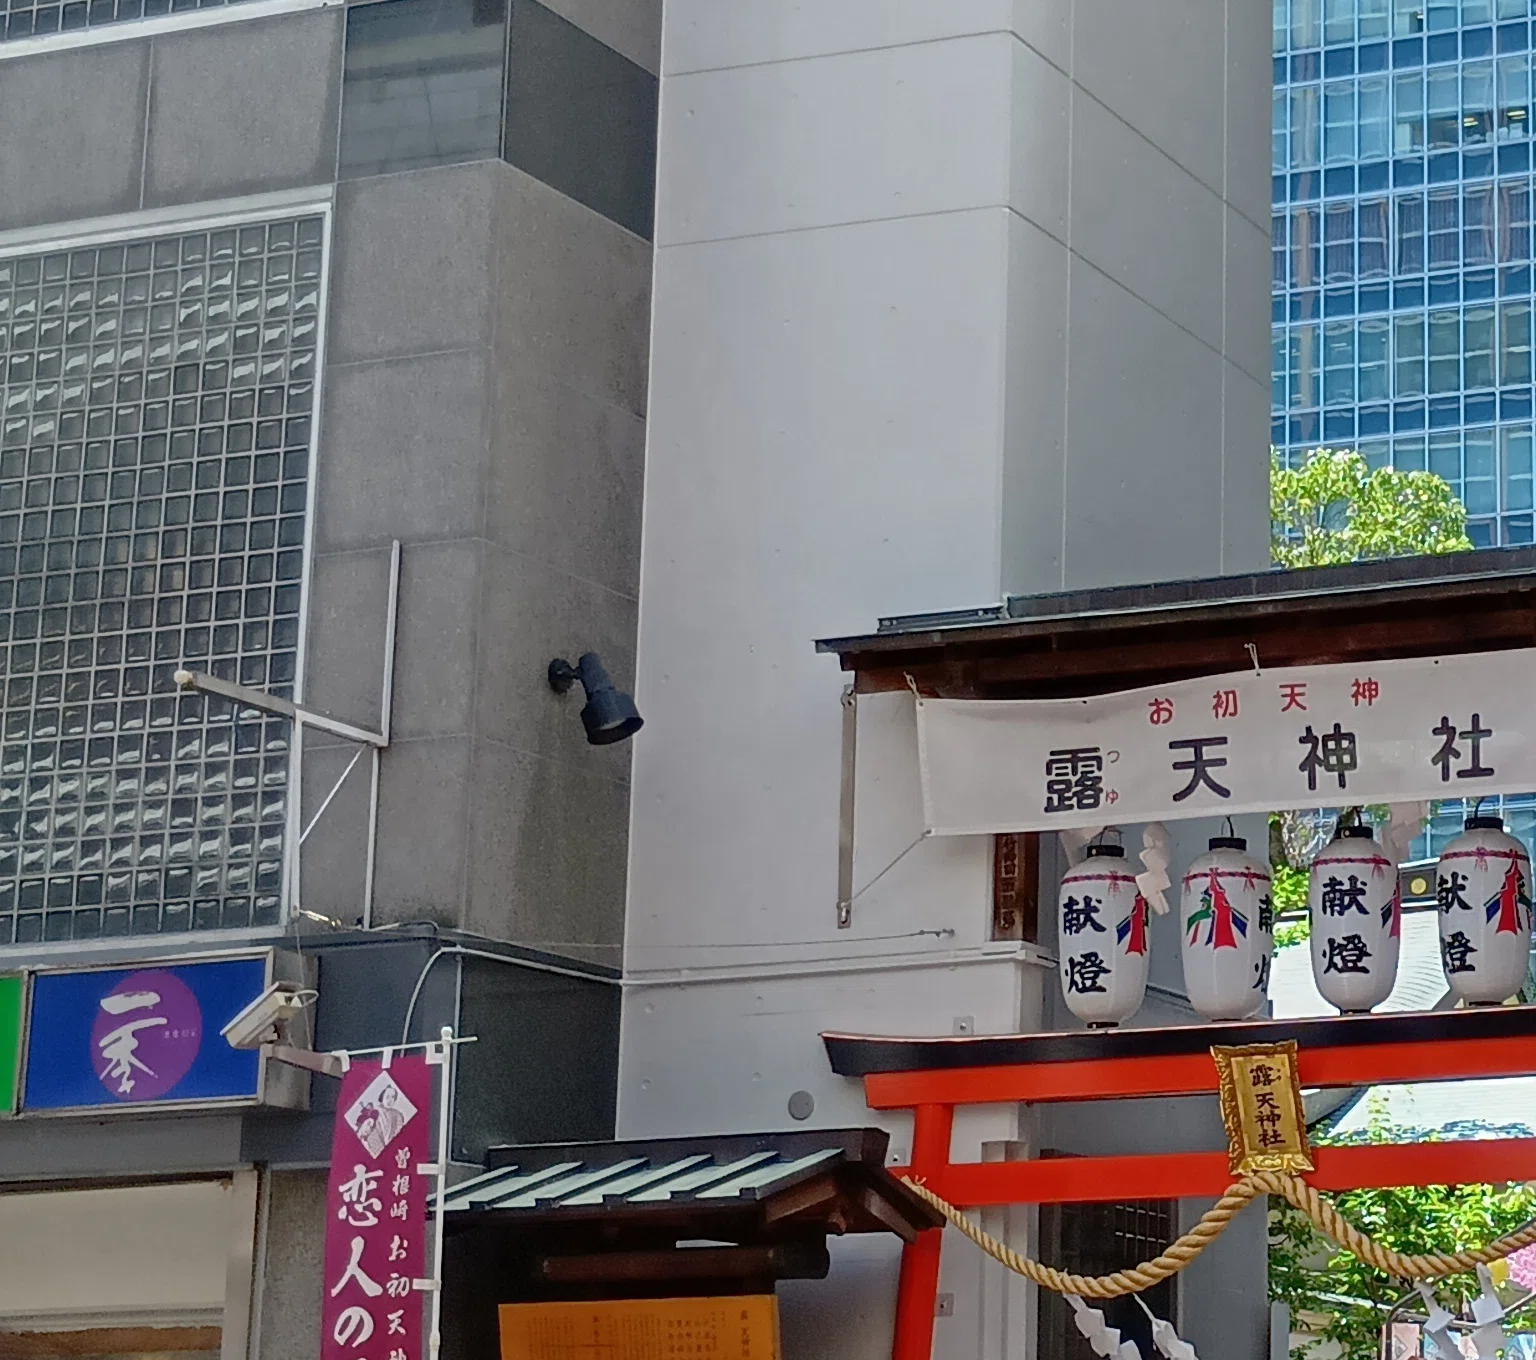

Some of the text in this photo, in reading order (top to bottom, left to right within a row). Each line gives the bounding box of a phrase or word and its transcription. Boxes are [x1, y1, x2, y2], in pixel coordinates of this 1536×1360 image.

[1148, 676, 1380, 726] お初天神
[1043, 712, 1496, 814] 露天神社
